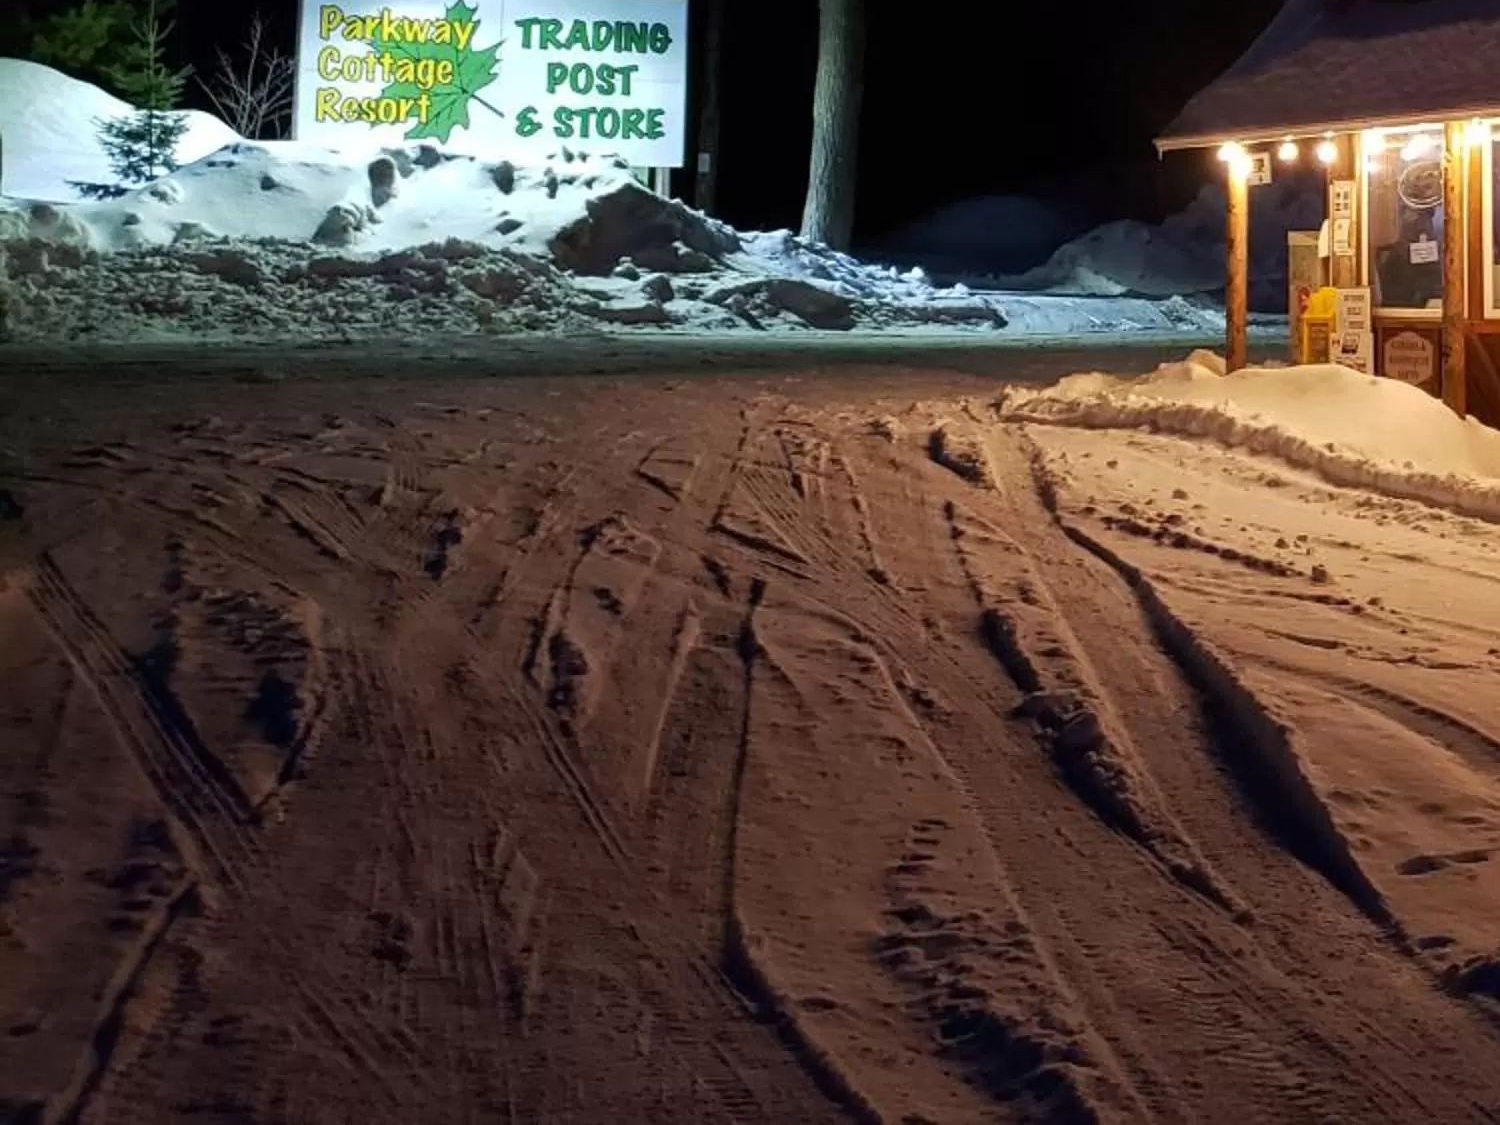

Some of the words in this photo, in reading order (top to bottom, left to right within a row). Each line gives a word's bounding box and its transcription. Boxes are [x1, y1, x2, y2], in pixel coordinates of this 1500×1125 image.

[319, 4, 474, 49] Parkway
[515, 17, 673, 54] TRADING
[318, 48, 454, 88] Cottage
[545, 61, 639, 96] POST
[315, 88, 431, 123] Resort
[515, 106, 542, 137] &
[552, 107, 666, 139] STORE
